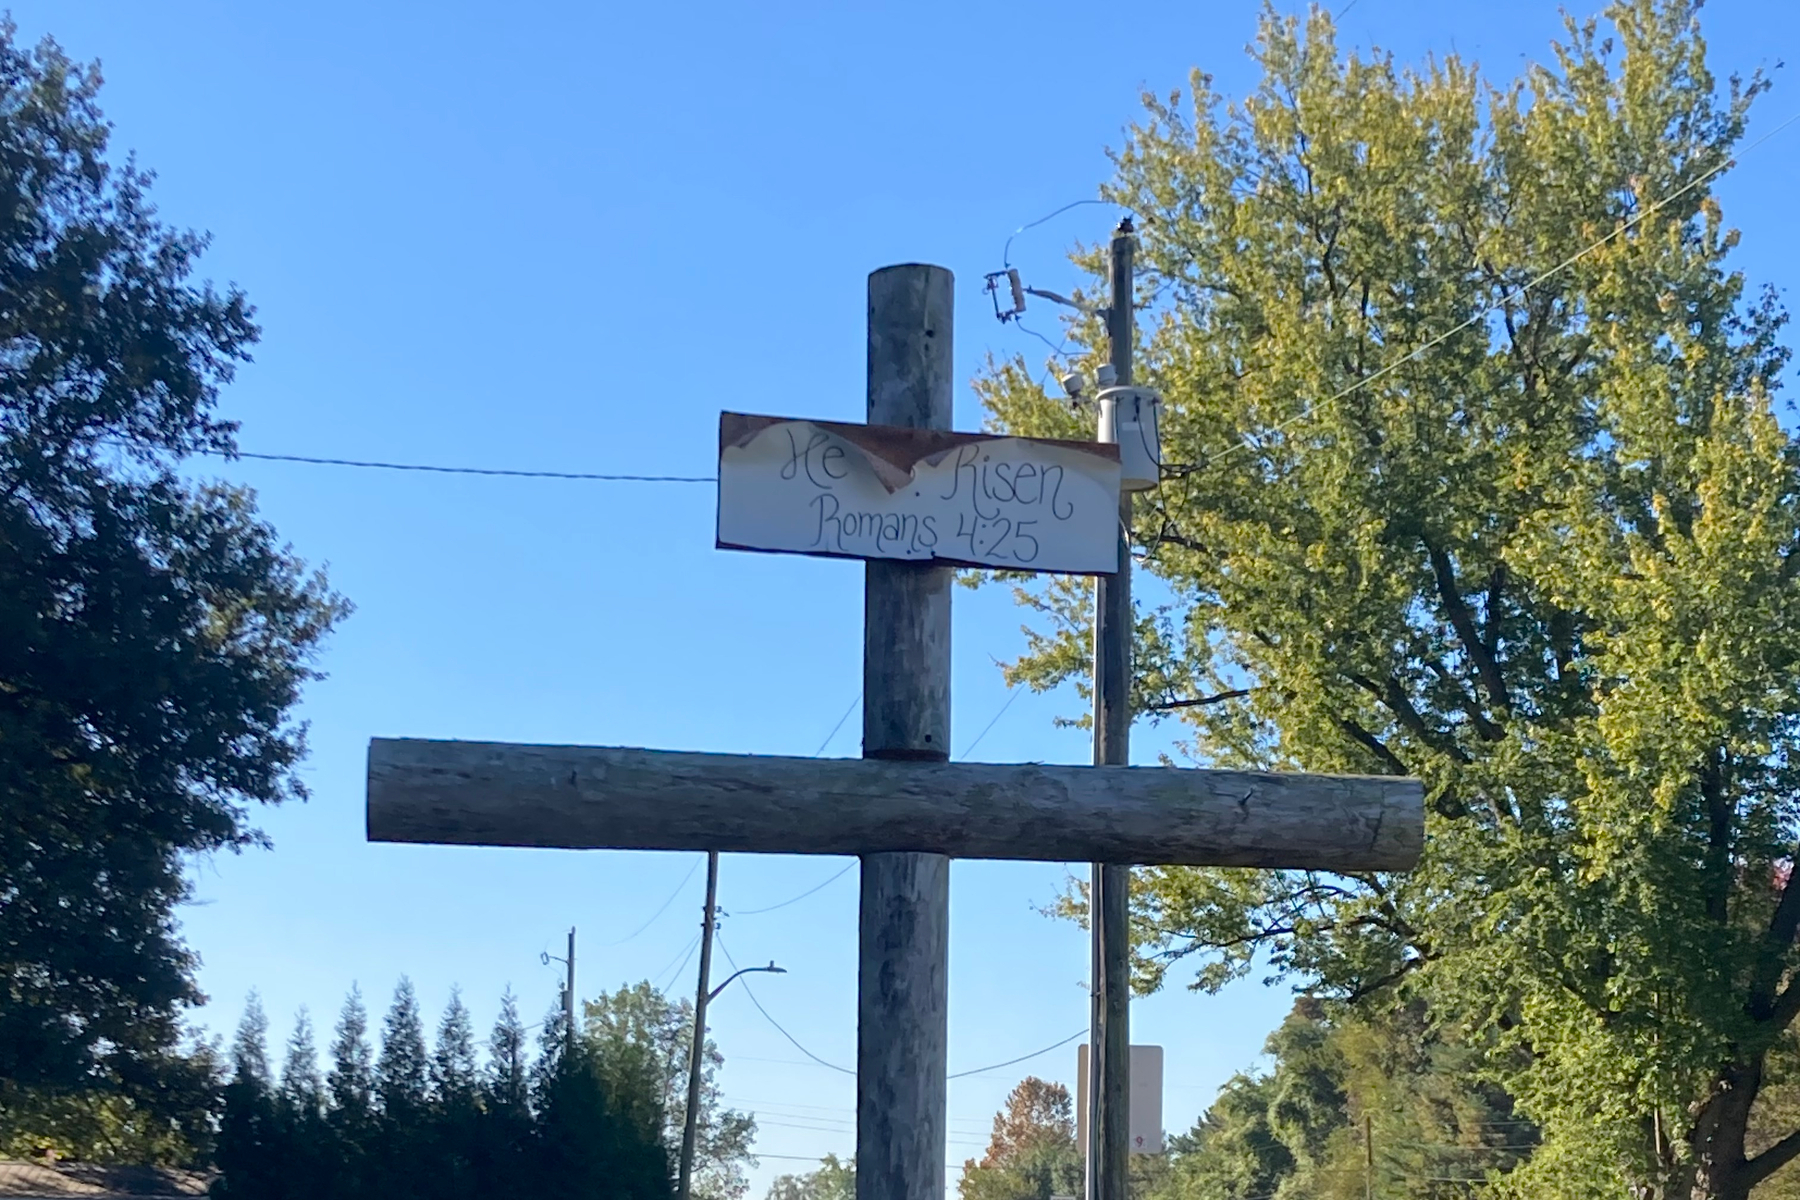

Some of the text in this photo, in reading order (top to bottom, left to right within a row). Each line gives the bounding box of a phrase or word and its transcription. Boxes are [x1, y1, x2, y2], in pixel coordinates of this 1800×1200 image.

[780, 428, 1074, 521] He Risen
[809, 493, 1039, 563] Romans 4:25
